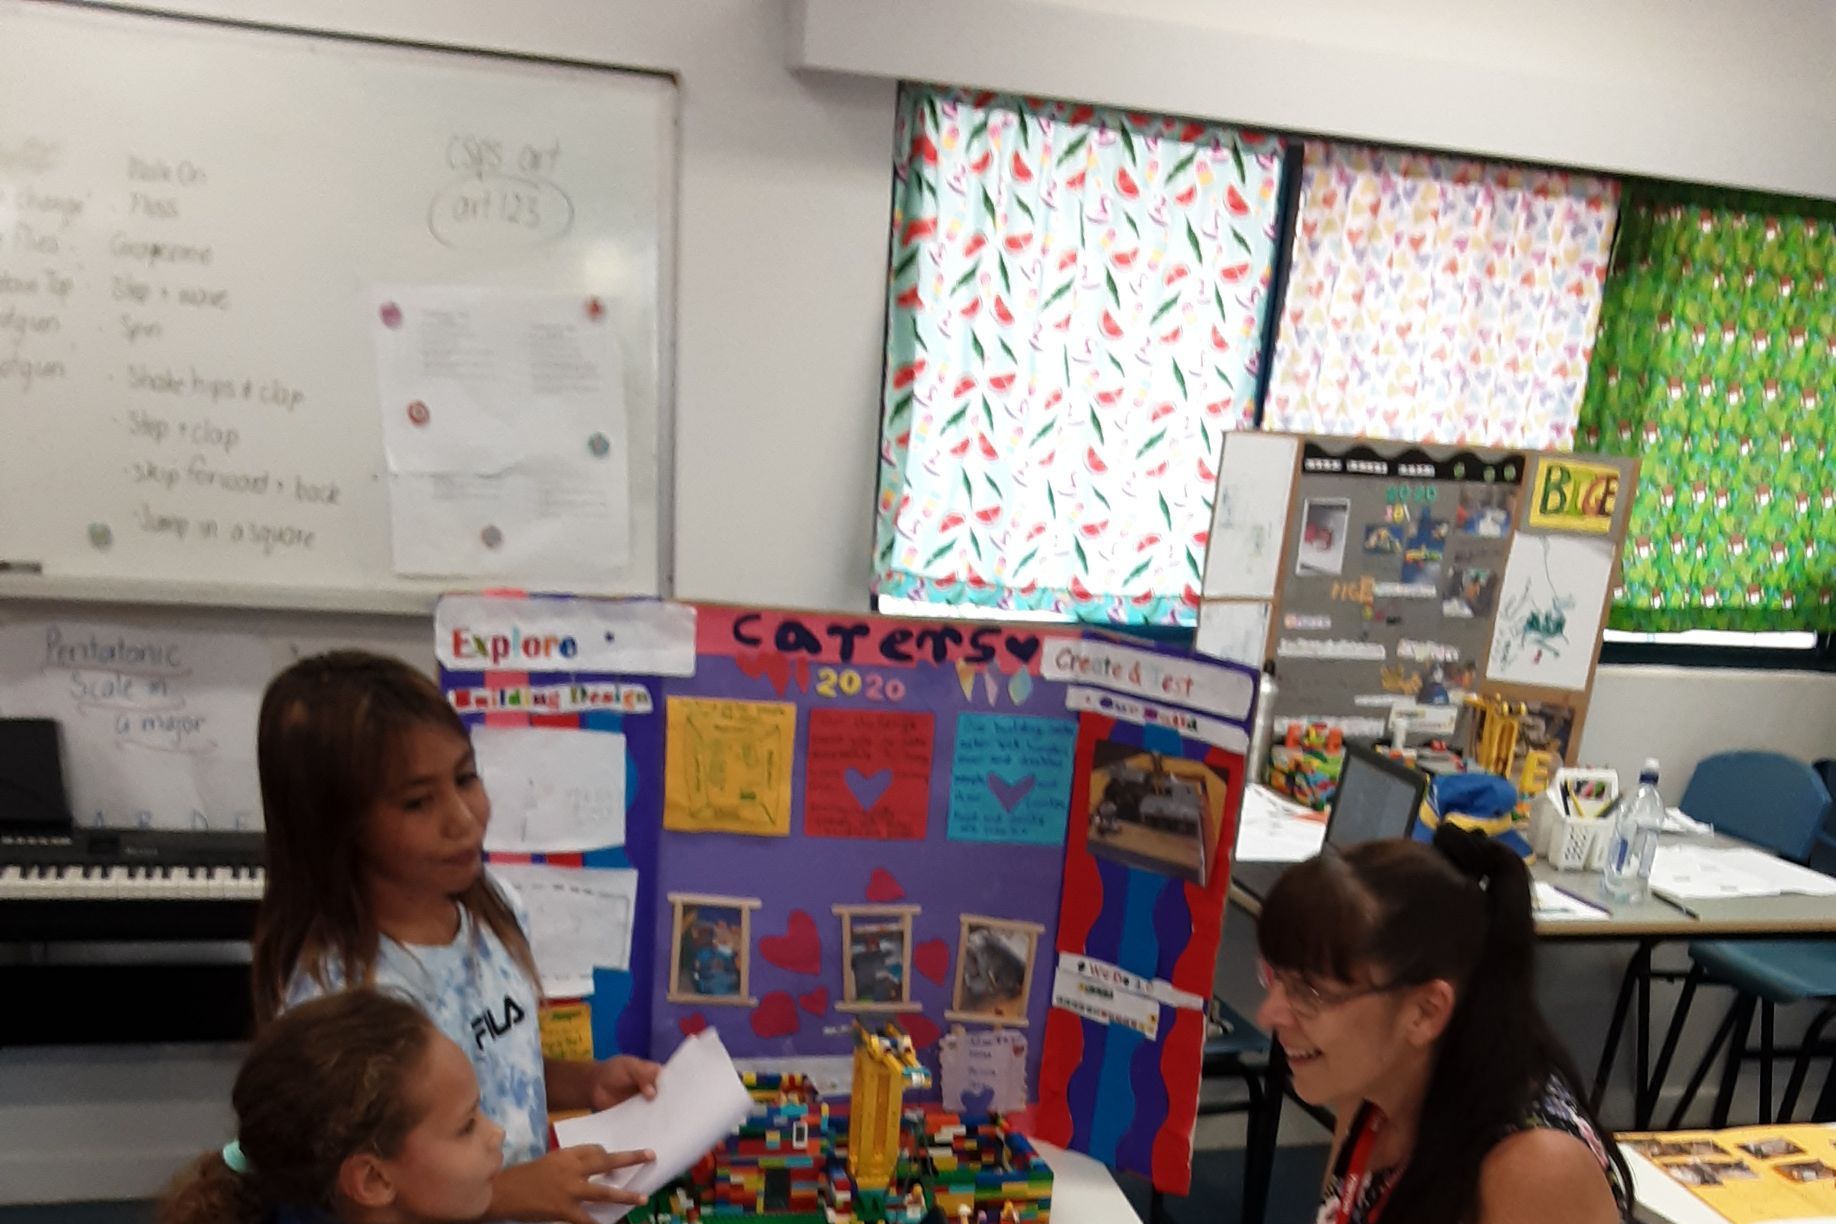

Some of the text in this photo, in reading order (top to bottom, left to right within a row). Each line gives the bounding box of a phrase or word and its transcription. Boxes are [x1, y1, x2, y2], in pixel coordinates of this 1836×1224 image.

[452, 628, 579, 664] Explore
[816, 667, 906, 701] 2020
[470, 994, 526, 1052] FILA
